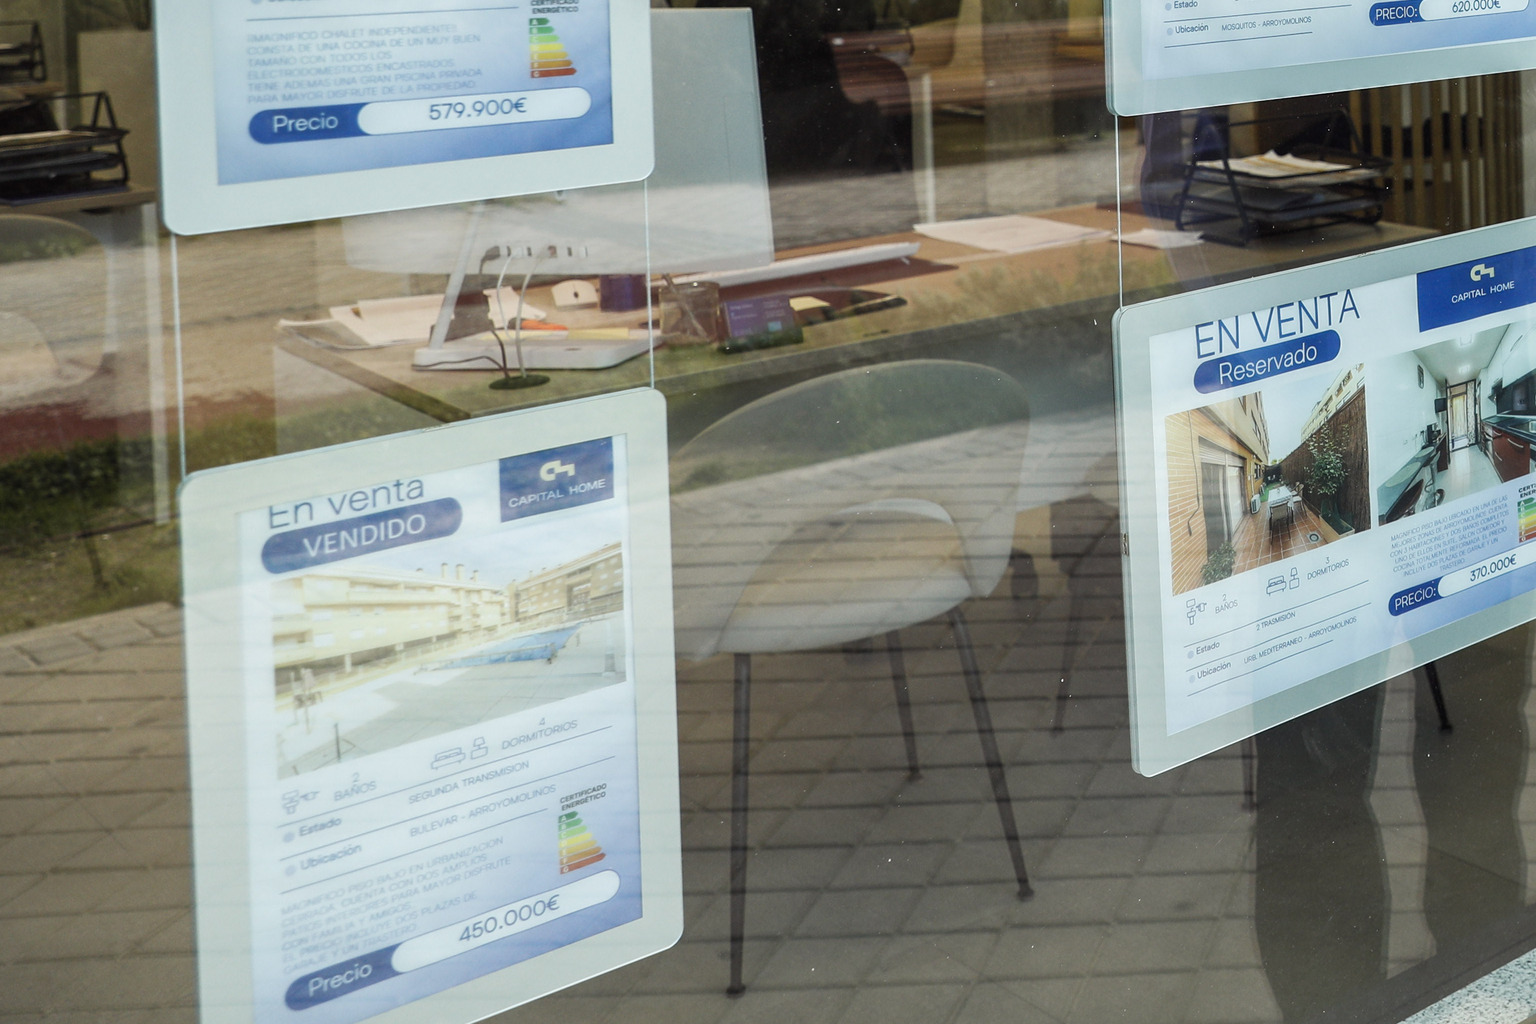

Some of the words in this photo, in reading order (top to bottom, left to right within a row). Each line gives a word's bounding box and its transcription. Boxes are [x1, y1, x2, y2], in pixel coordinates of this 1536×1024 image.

[531, 5, 579, 15] ENERGÉTICO
[1173, 0, 1198, 9] Estado
[1375, 5, 1418, 21] PRECIO:
[1175, 22, 1209, 35] Ubicación
[1221, 21, 1257, 32] MOSQUITOS
[1262, 16, 1312, 27] ARROYOMOLINOS
[273, 112, 339, 133] Precio
[428, 97, 528, 121] 579.900€
[1451, 288, 1487, 304] CAPITAL
[1490, 280, 1515, 294] HOME
[1194, 315, 1241, 360] EN
[1251, 289, 1360, 343] VENTA
[1218, 343, 1317, 385] Reservado
[269, 499, 313, 529] En
[327, 479, 424, 515] venta
[508, 489, 564, 508] CAPITAL
[568, 479, 607, 494] HOME
[303, 514, 427, 558] VENDIDO
[1307, 559, 1350, 581] DORMITORIOS
[1395, 586, 1436, 610] PRECIO:
[1470, 553, 1517, 582] 370.000€
[1214, 599, 1238, 615] BAÑOS
[1196, 640, 1220, 655] Estado
[1197, 660, 1232, 679] Ubicación
[501, 719, 578, 750] DORMITORIOS
[333, 781, 377, 802] BAÑOS
[408, 782, 459, 805] SEGUNDA
[461, 760, 530, 788] TRANSMISION
[559, 783, 608, 805] CERTIFICADO
[561, 791, 607, 812] ENERGÉTICO
[299, 816, 342, 837] Estado
[300, 843, 362, 871] Ubicación
[307, 962, 373, 997] Precio
[458, 893, 561, 943] 450.000€
